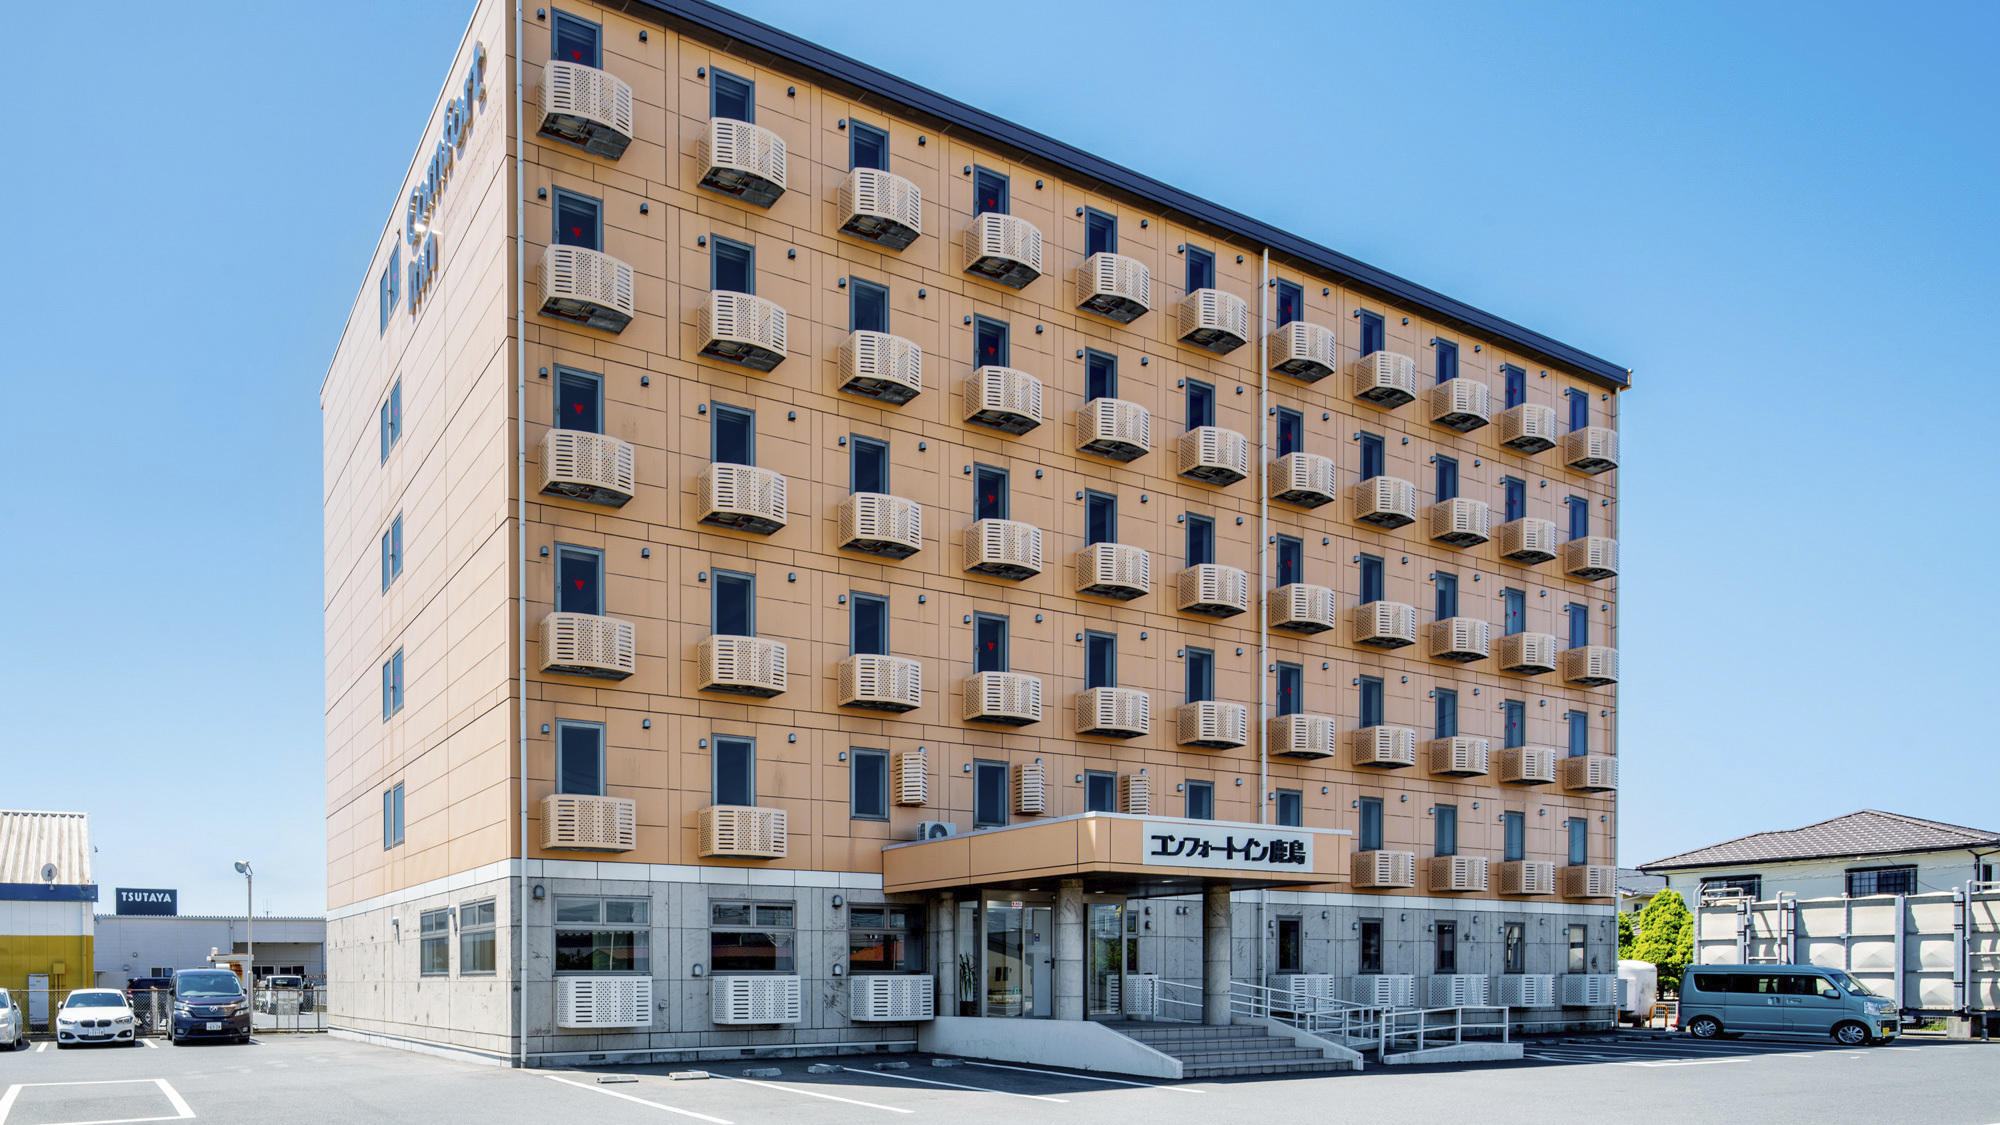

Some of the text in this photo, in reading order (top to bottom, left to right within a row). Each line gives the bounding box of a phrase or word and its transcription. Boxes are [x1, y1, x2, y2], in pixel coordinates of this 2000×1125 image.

[407, 41, 486, 246] Comfort
[408, 230, 438, 316] Inn
[1151, 835, 1306, 864] コンフォートイン鹿島
[121, 891, 172, 903] TSUTAYA
